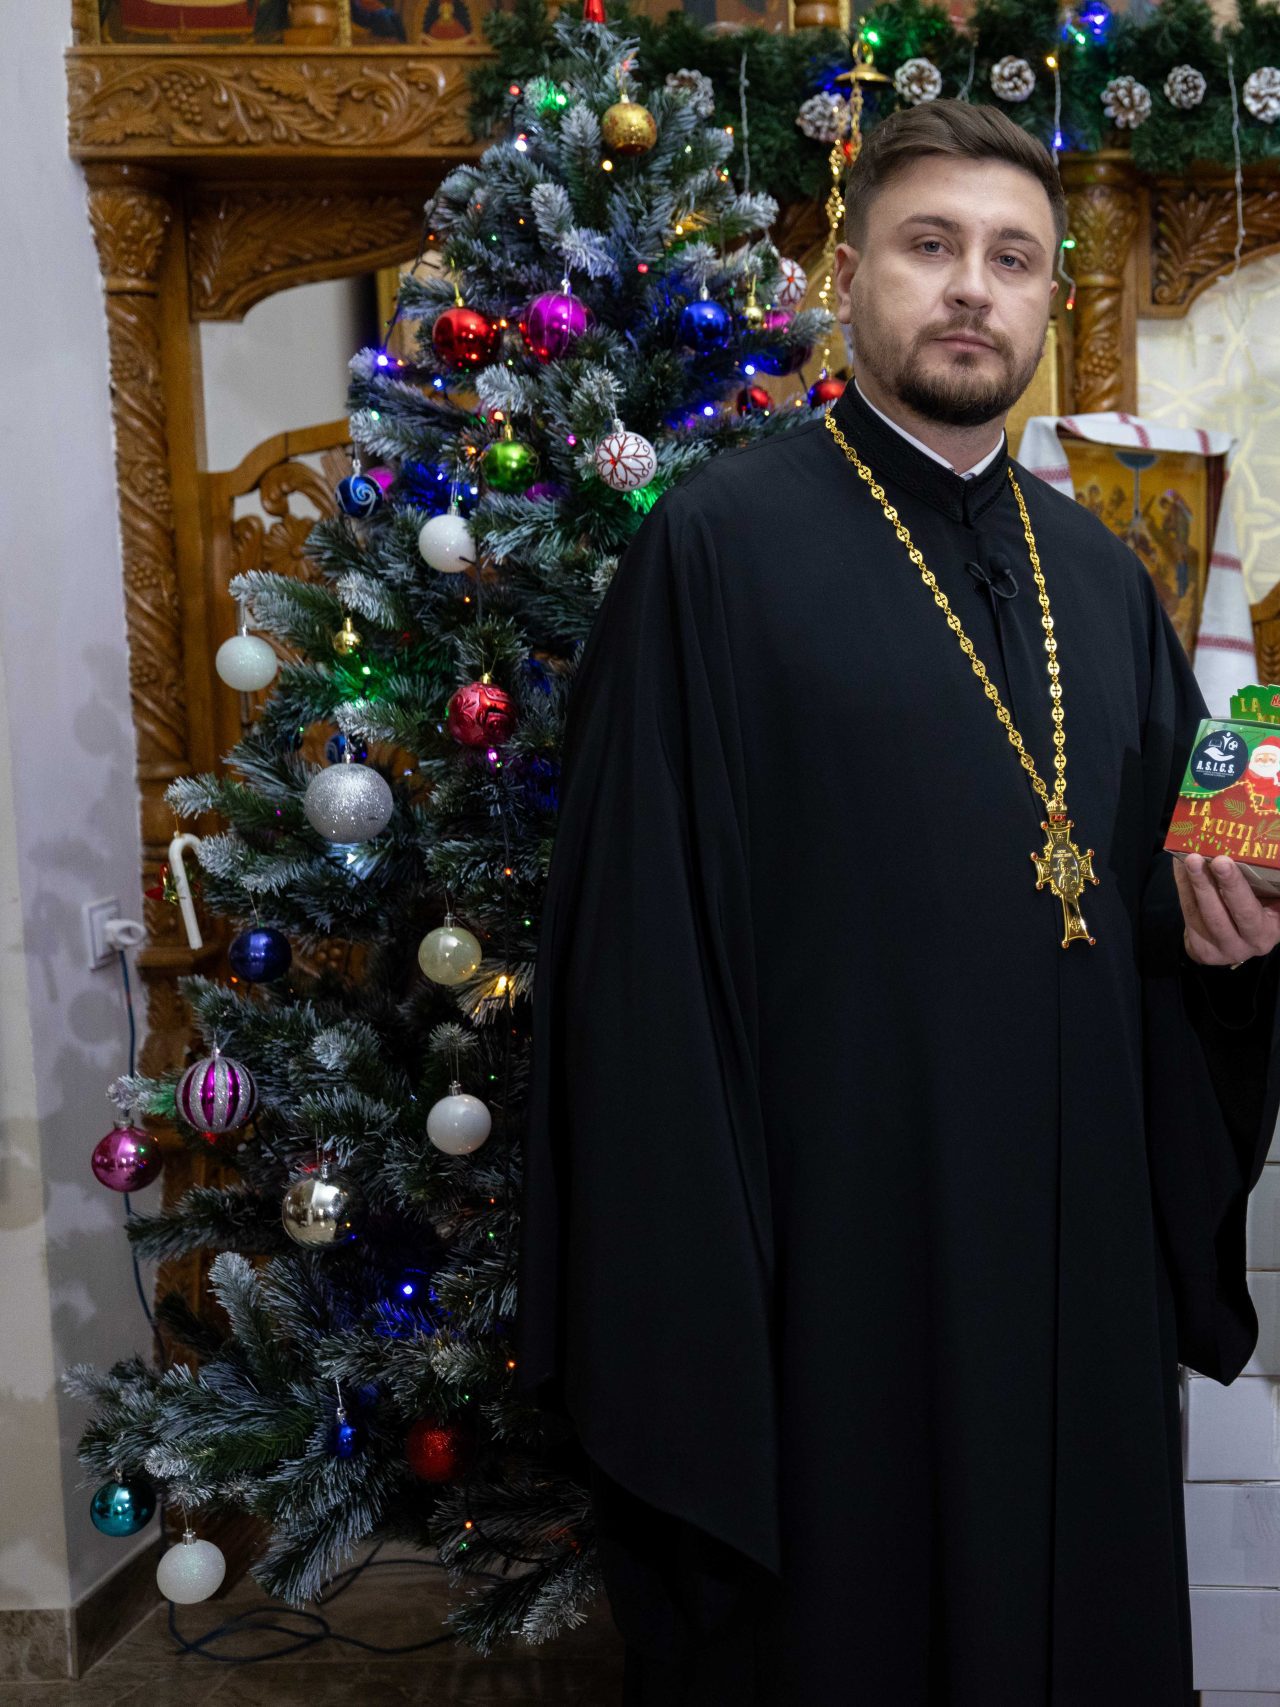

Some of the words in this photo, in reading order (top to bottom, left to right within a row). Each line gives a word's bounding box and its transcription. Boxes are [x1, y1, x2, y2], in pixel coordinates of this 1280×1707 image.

[1240, 697, 1260, 713] LA
[1190, 802, 1213, 817] LA
[1201, 816, 1255, 842] MULTI
[1238, 841, 1279, 860] ANI!
